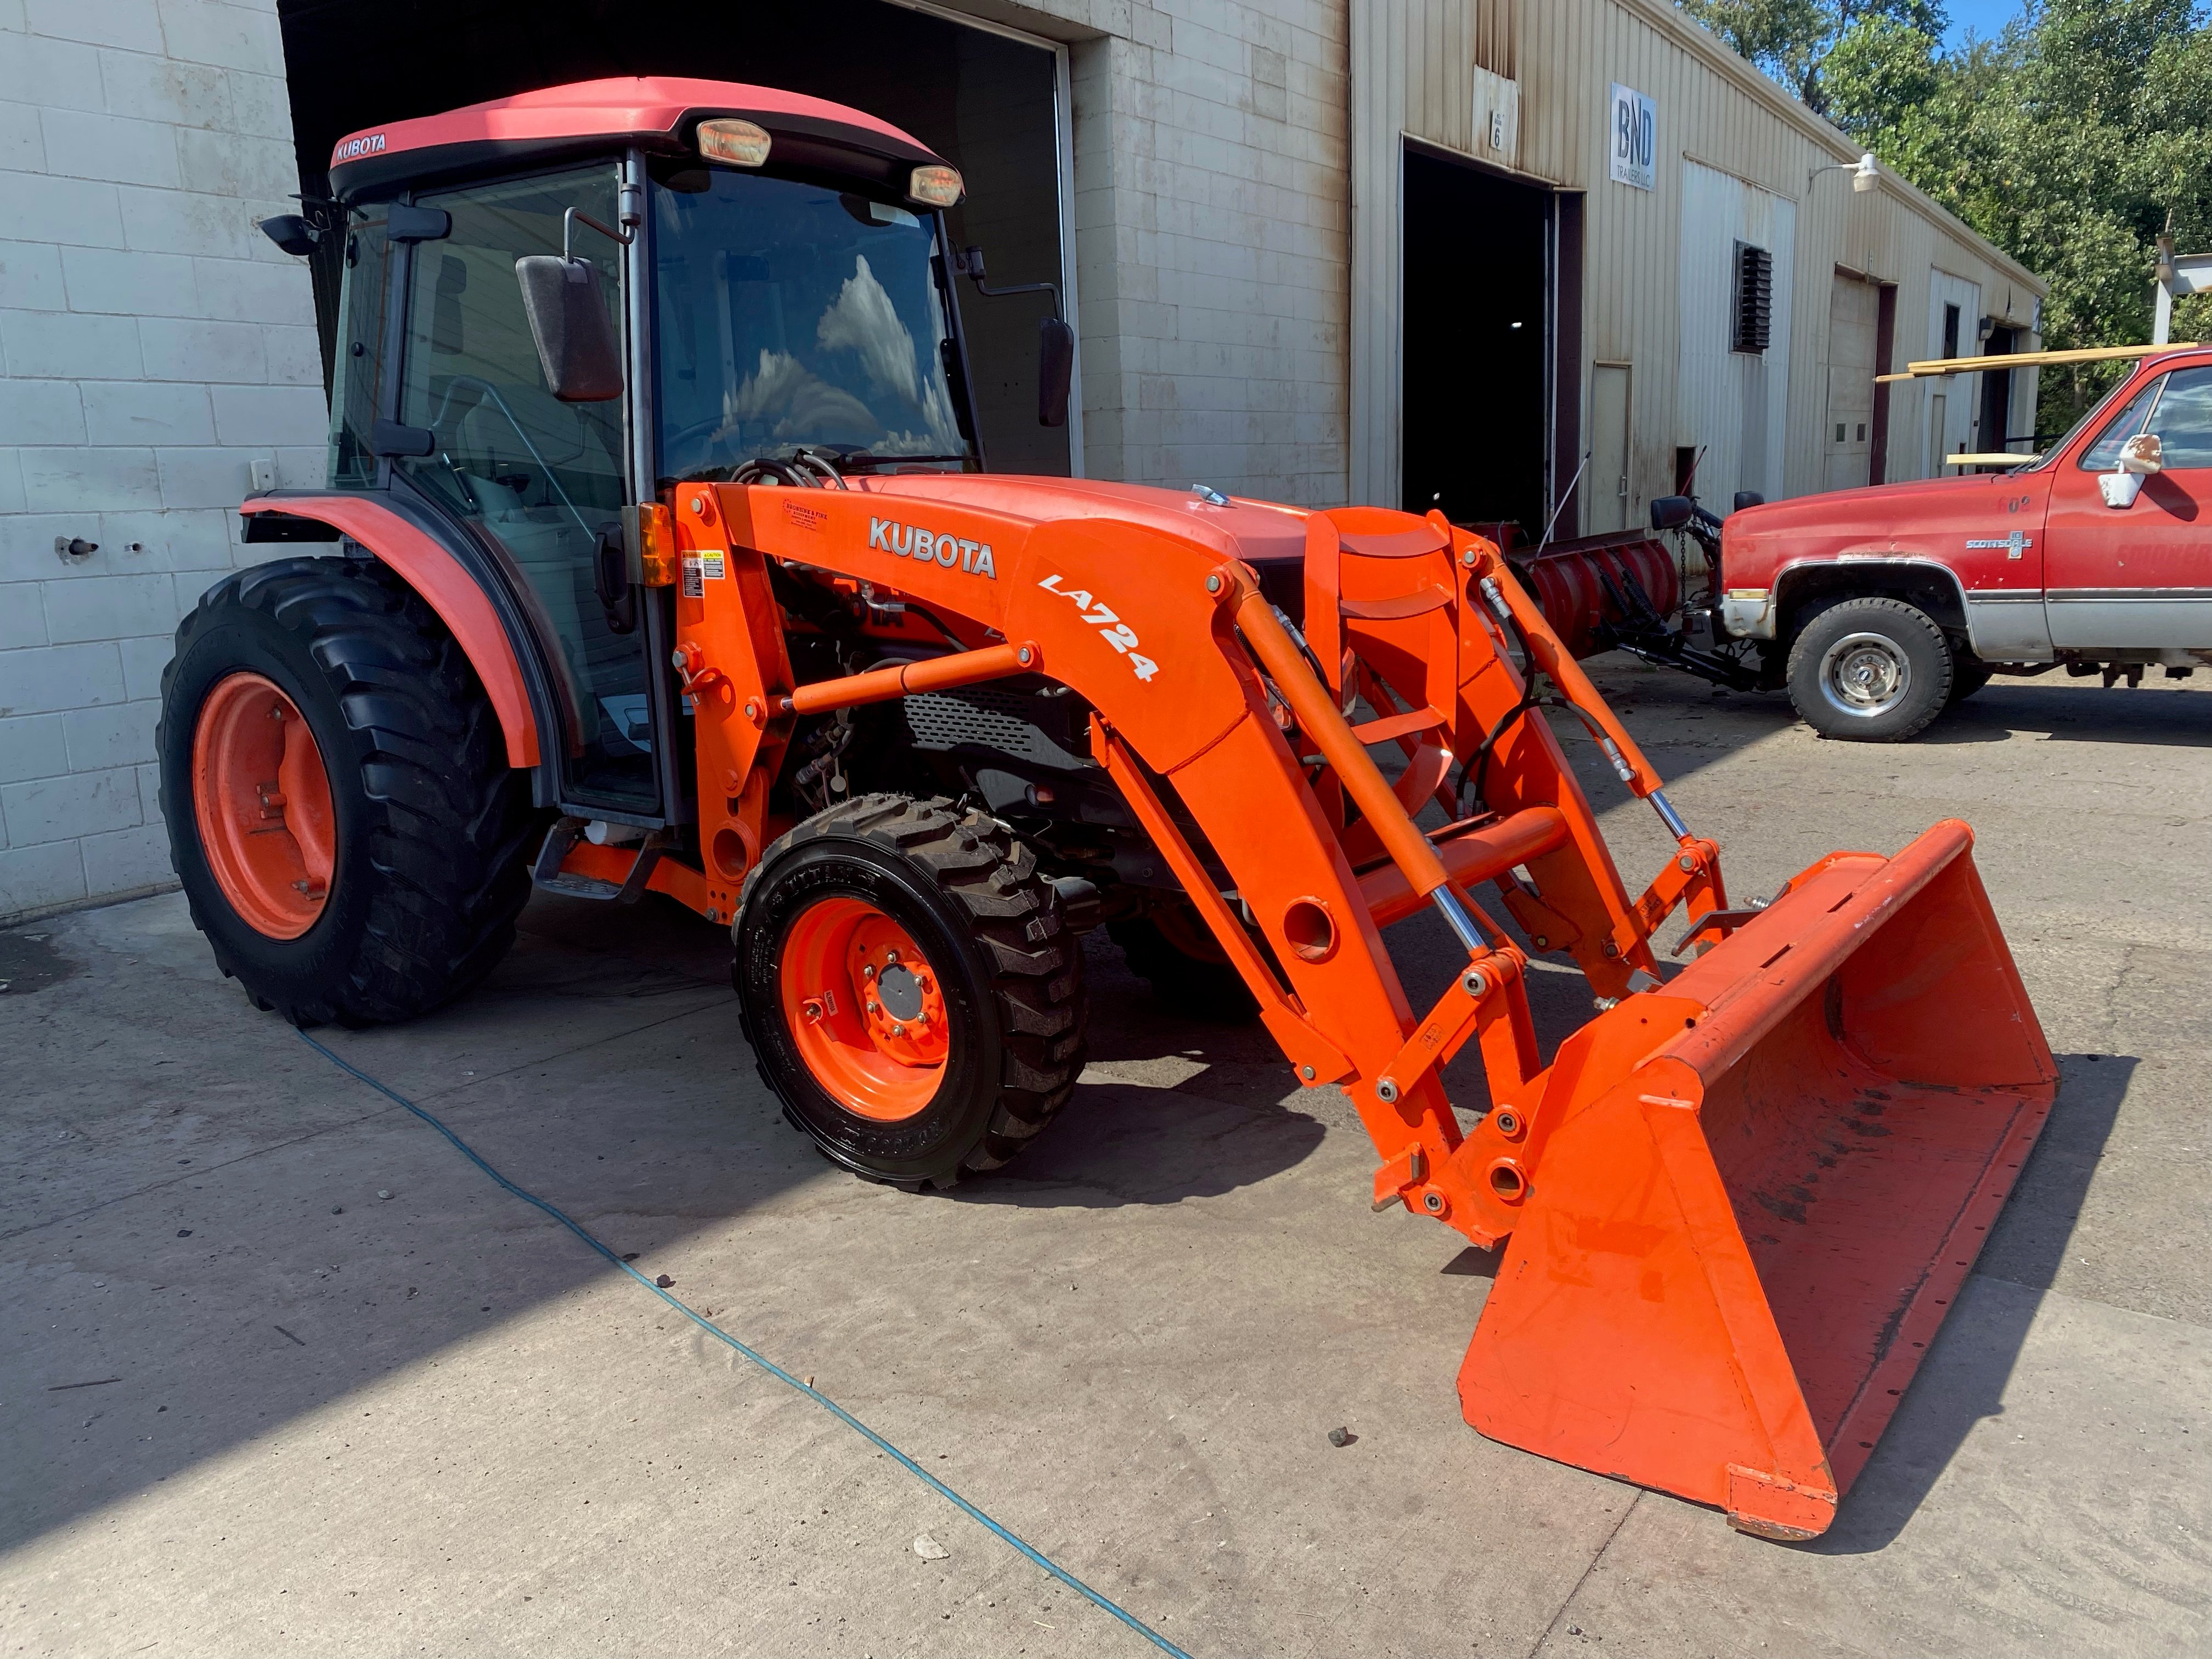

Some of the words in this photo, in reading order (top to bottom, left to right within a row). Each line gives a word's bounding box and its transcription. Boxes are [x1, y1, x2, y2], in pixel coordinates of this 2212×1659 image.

[1494, 127, 1500, 146] 6
[1617, 93, 1651, 169] BND
[336, 133, 386, 161] KUBOTA
[1617, 165, 1640, 184] TRAILERS
[1640, 172, 1650, 187] LLC
[869, 516, 997, 580] KUBOTA
[1966, 538, 2033, 549] SCOTTSDALE
[1037, 574, 1159, 682] LA724
